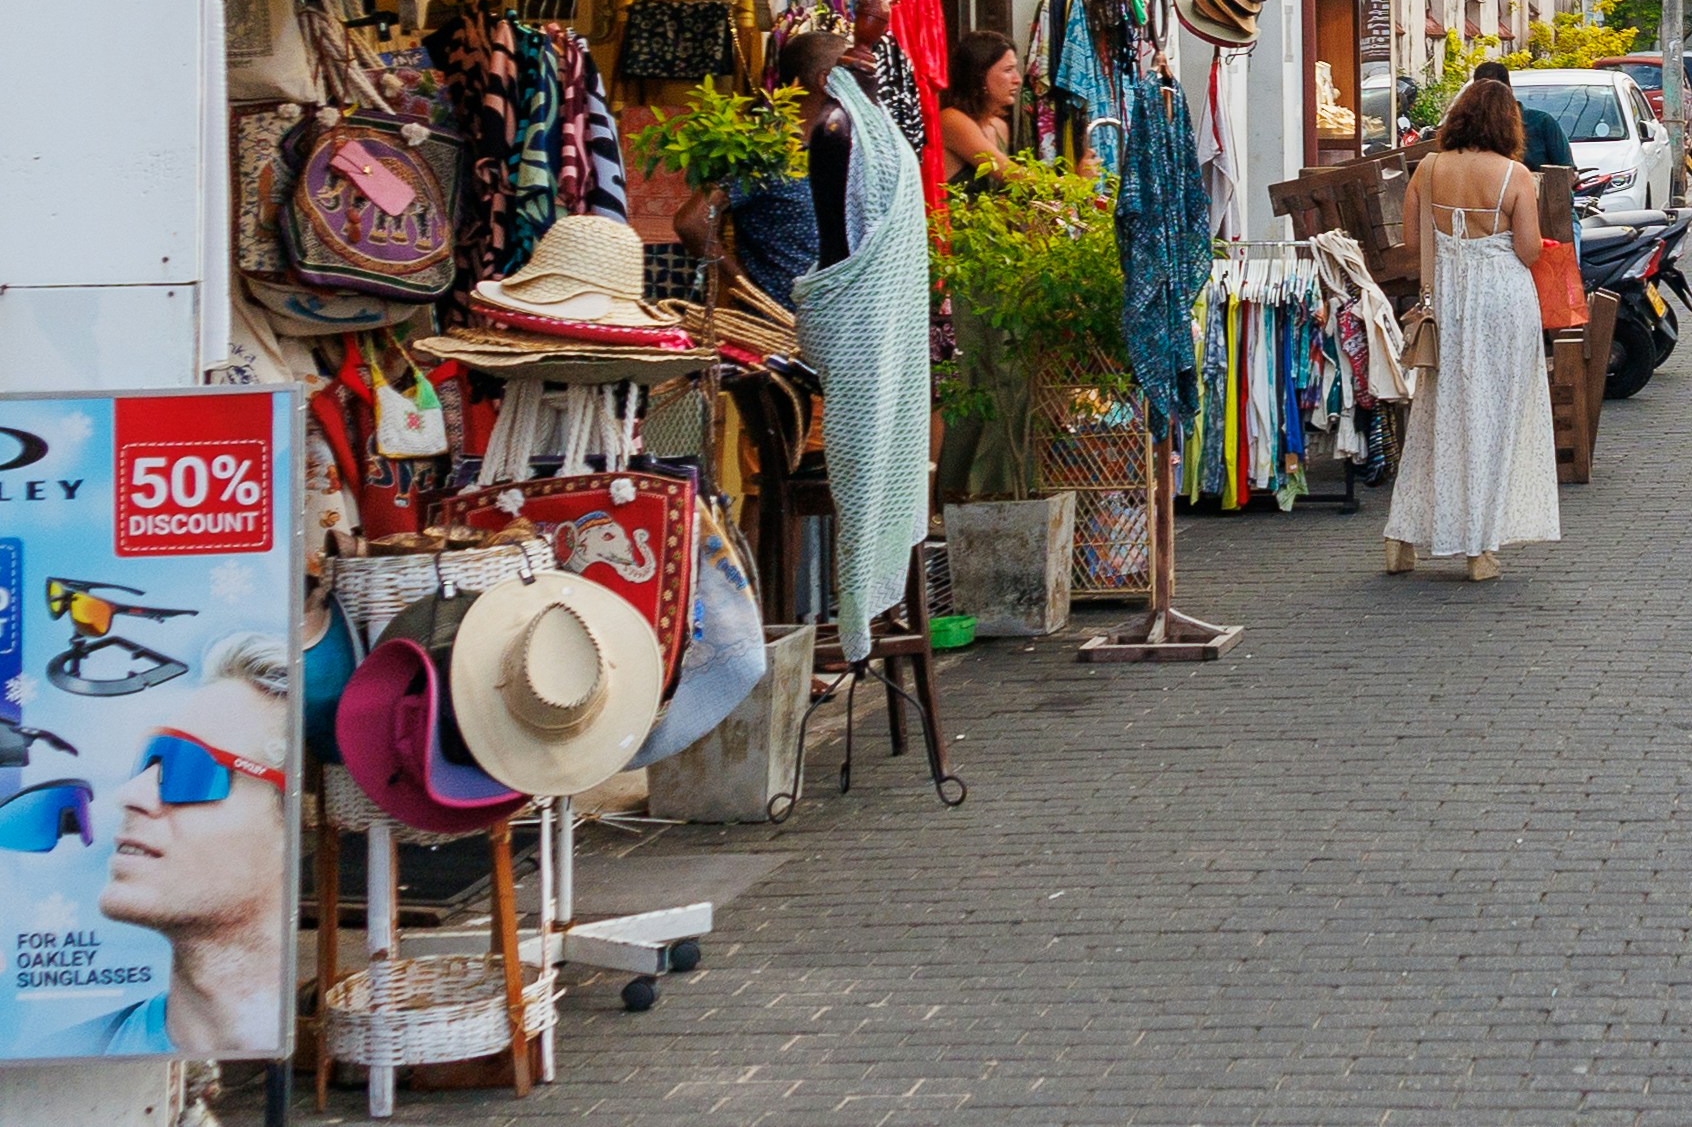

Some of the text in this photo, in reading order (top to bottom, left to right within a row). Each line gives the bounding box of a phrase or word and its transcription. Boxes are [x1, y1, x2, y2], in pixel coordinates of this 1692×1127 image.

[131, 455, 261, 509] 50%
[128, 511, 260, 537] DISCOUNT
[17, 931, 101, 950] FOR ALL
[17, 950, 97, 969] OAKLEY
[16, 966, 152, 989] SUNGLASSES
